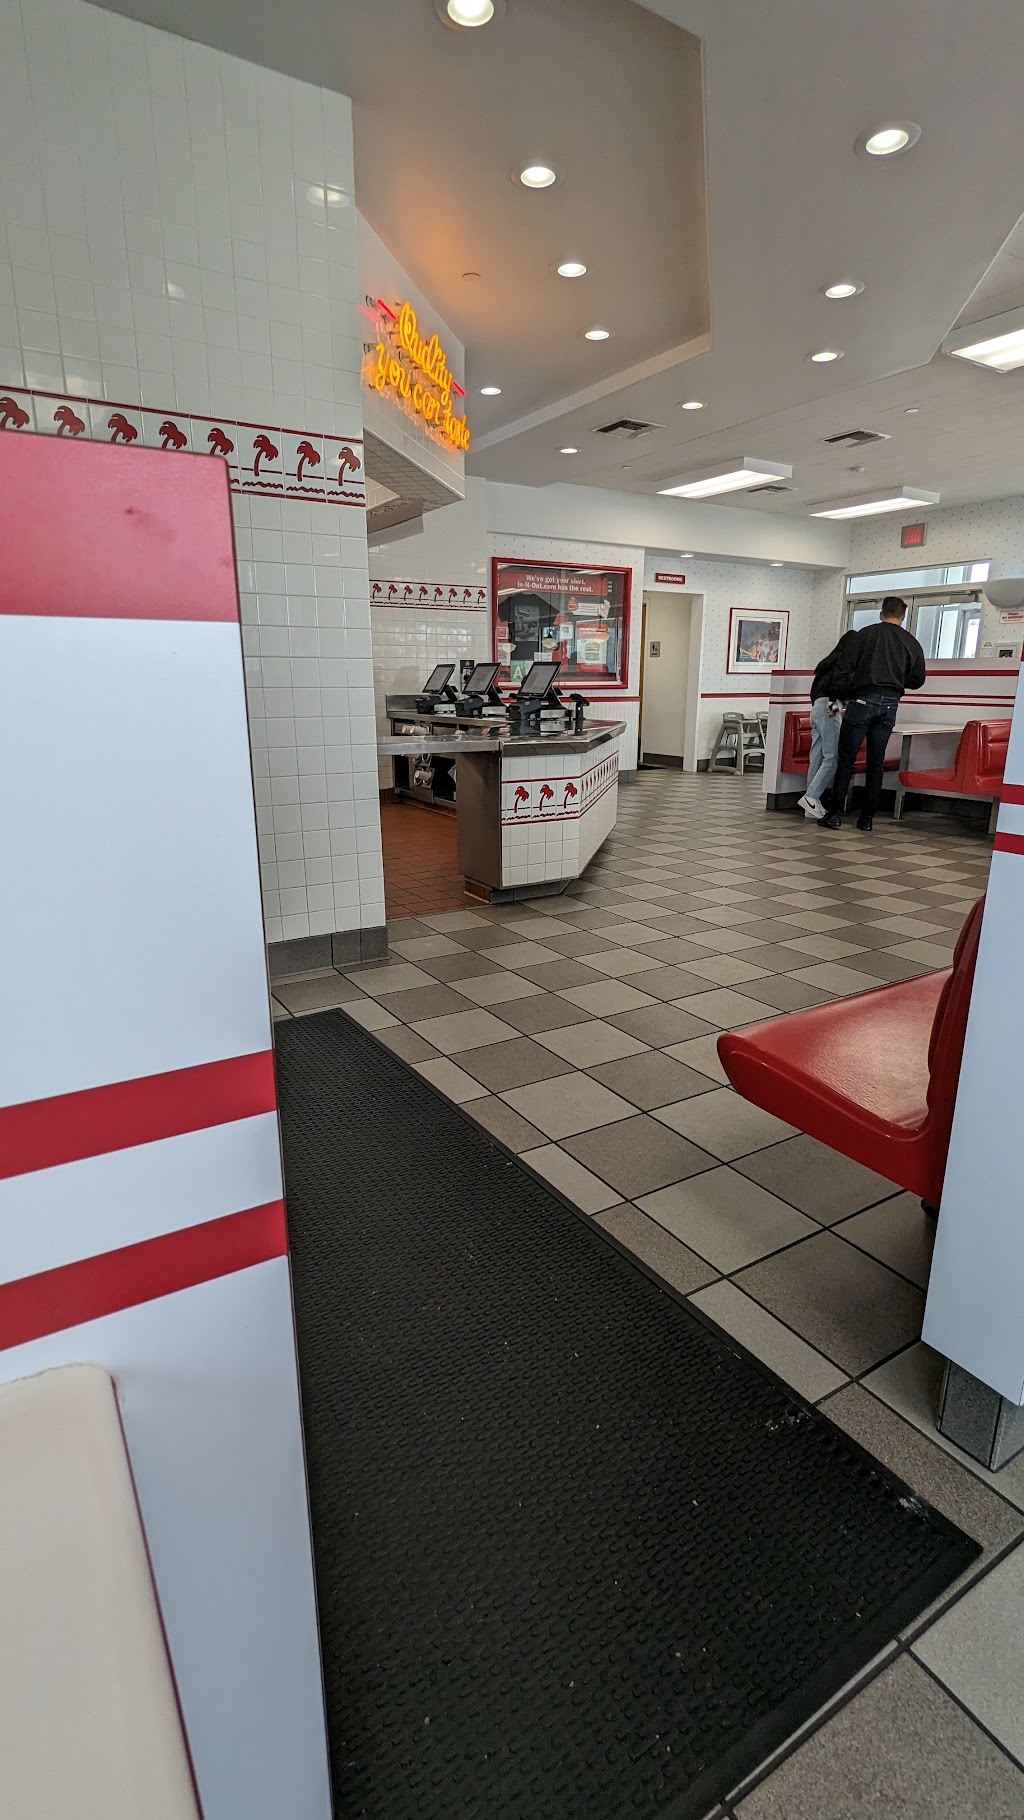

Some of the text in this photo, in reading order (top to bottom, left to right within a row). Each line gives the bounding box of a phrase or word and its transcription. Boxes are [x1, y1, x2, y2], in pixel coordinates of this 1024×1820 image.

[399, 301, 453, 405] Quality
[443, 399, 471, 451] taste
[904, 527, 922, 545] EXIT
[525, 574, 543, 583] We've
[557, 583, 568, 591] has
[513, 665, 523, 679] A
